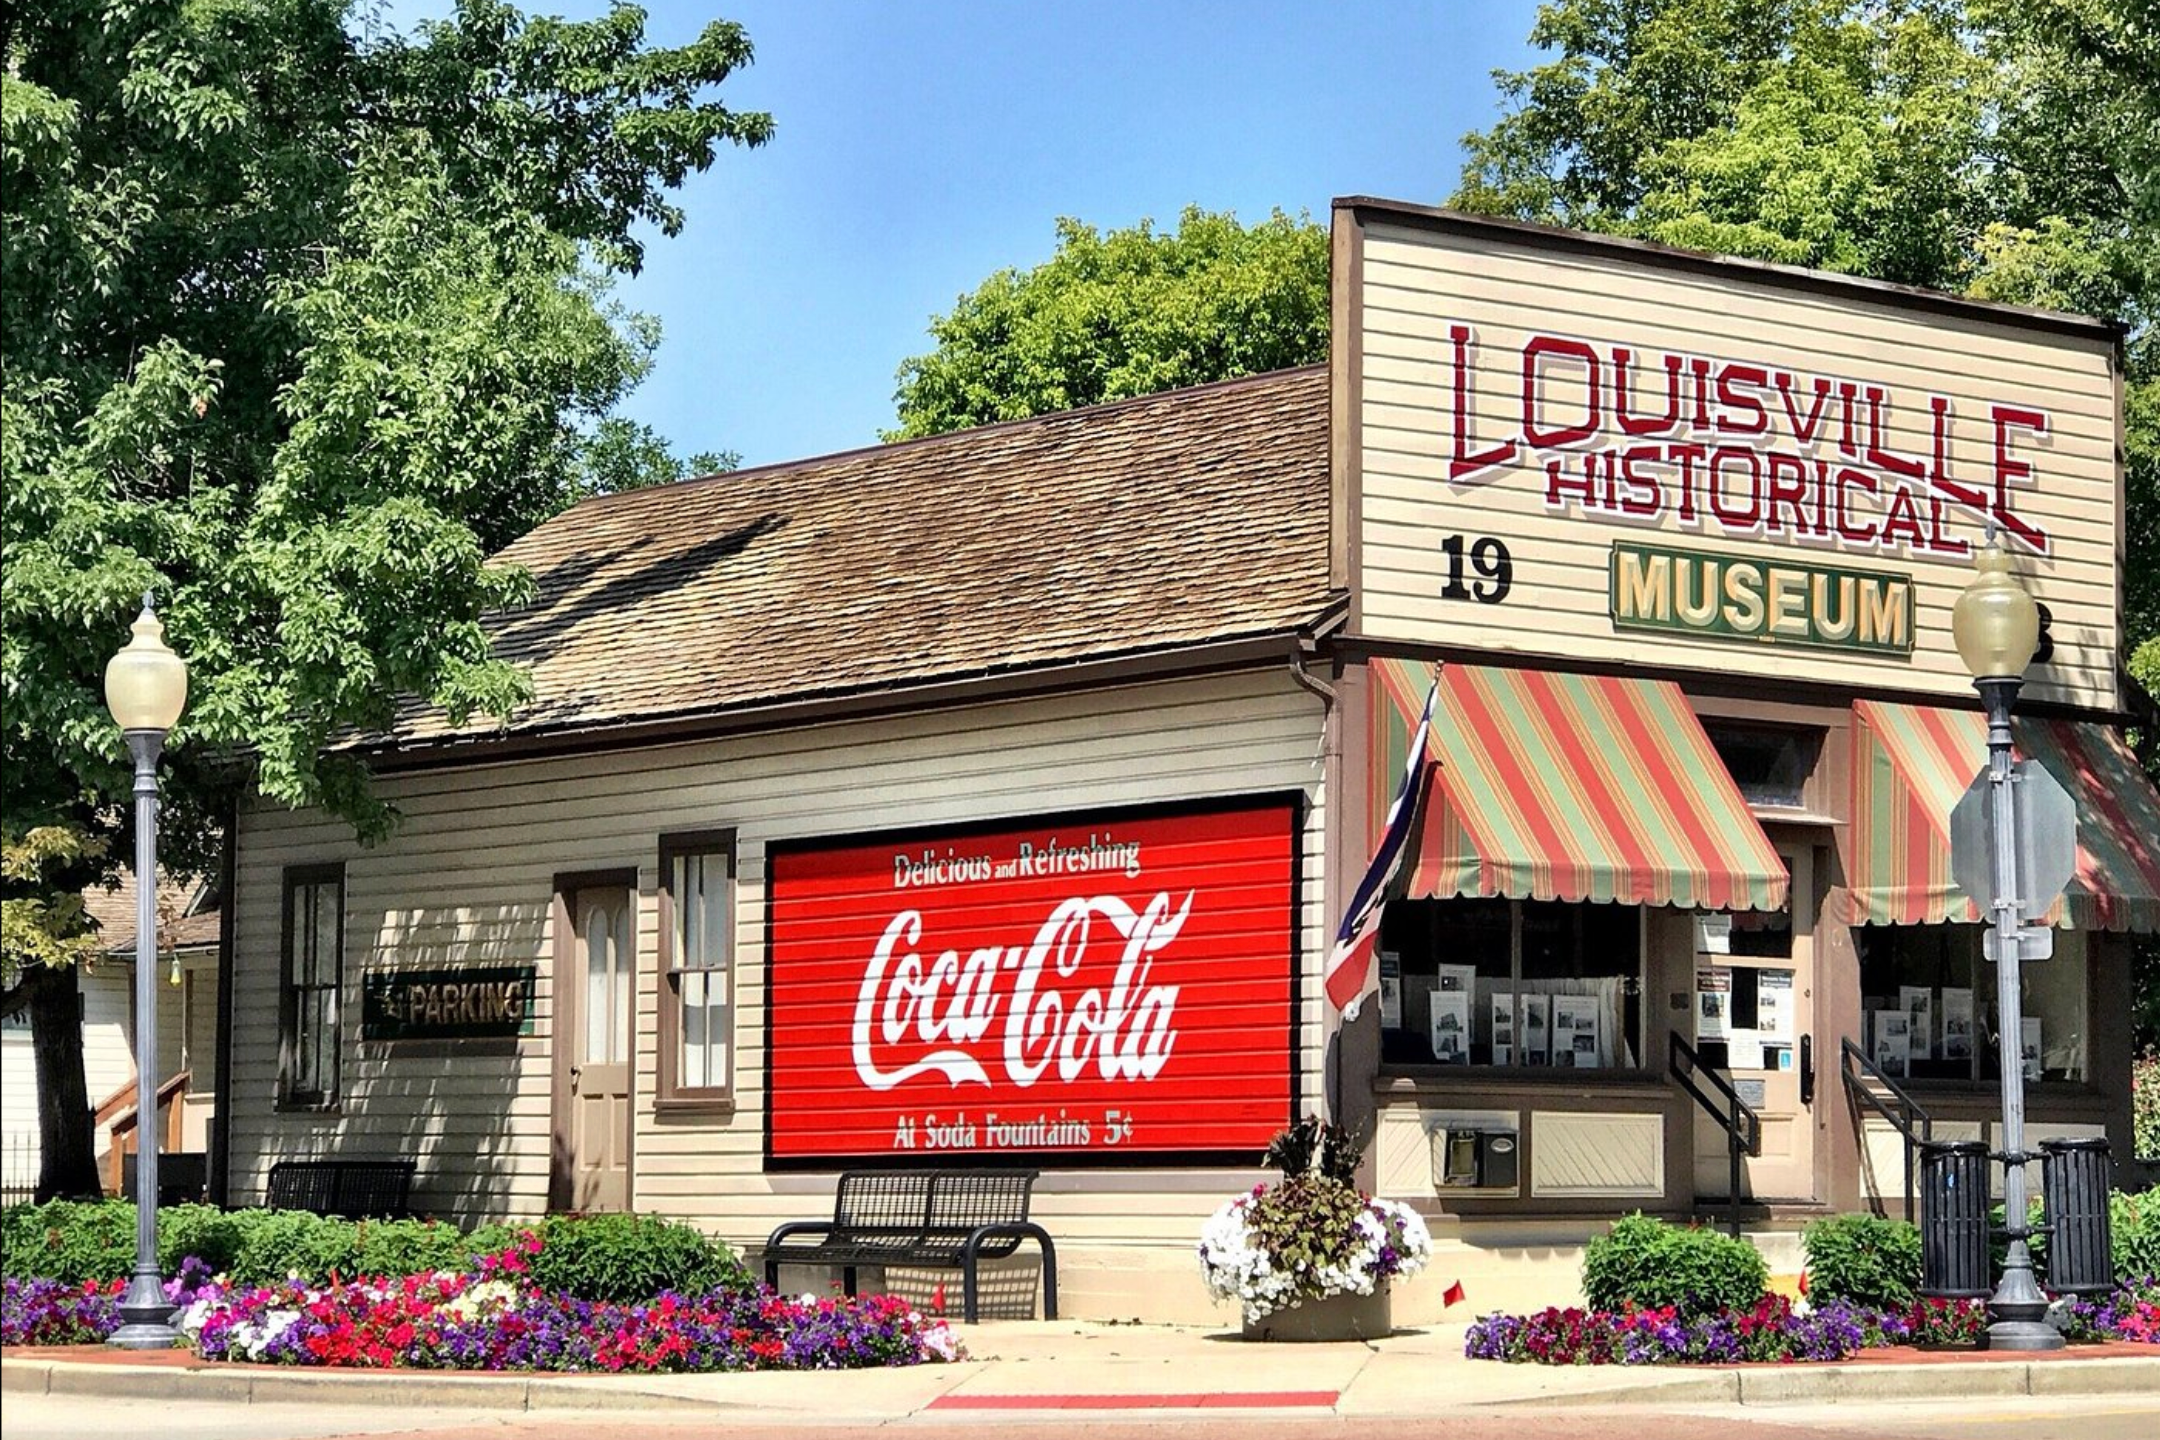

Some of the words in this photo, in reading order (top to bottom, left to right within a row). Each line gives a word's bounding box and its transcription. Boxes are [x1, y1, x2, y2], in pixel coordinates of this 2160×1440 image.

[1449, 324, 2048, 554] LOUISVILLE
[1545, 443, 1971, 556] HISTORICAL
[1441, 534, 1512, 604] 19
[1618, 551, 1909, 646] MUSEUM
[894, 846, 991, 888] Delicious
[994, 858, 1017, 879] and
[1019, 832, 1141, 879] Refreshing
[410, 981, 524, 1025] PARKING
[852, 887, 1196, 1091] Coca-Cola
[893, 1115, 916, 1148] At
[925, 1111, 977, 1148] Soda
[985, 1108, 1091, 1147] Fountains
[1103, 1109, 1134, 1145] 5¢
